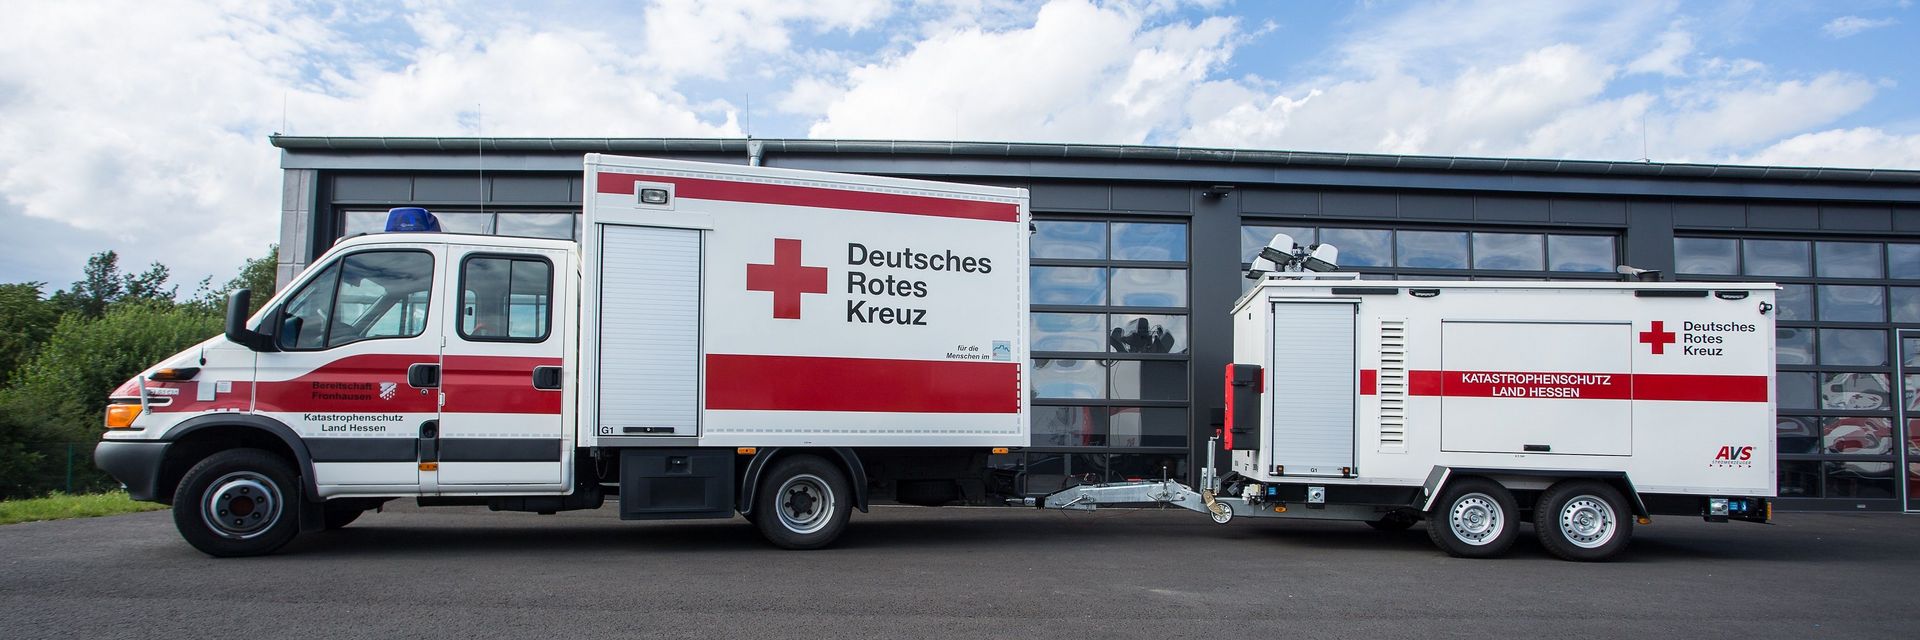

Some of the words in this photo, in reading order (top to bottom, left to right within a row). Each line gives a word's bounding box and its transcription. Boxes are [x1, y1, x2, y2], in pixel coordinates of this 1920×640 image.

[847, 242, 992, 274] Deutsches
[847, 271, 928, 298] Rotes
[847, 300, 927, 326] Kreuz
[1683, 321, 1756, 332] Deutsches
[1683, 333, 1723, 344] Rotes
[946, 352, 980, 360] Menschen
[1683, 345, 1723, 356] Kreuz
[1462, 373, 1612, 386] KATASTROPHENSCHUTZ
[312, 381, 372, 390] Bereitschaft
[312, 391, 372, 400] Fronhausen
[1492, 386, 1526, 397] LAND
[1529, 387, 1580, 398] HESSEN
[304, 413, 404, 423] Katastrophenschutz
[321, 424, 347, 432] Land
[349, 424, 386, 432] Hessen
[601, 426, 614, 434] G1
[1715, 446, 1753, 461] AVS
